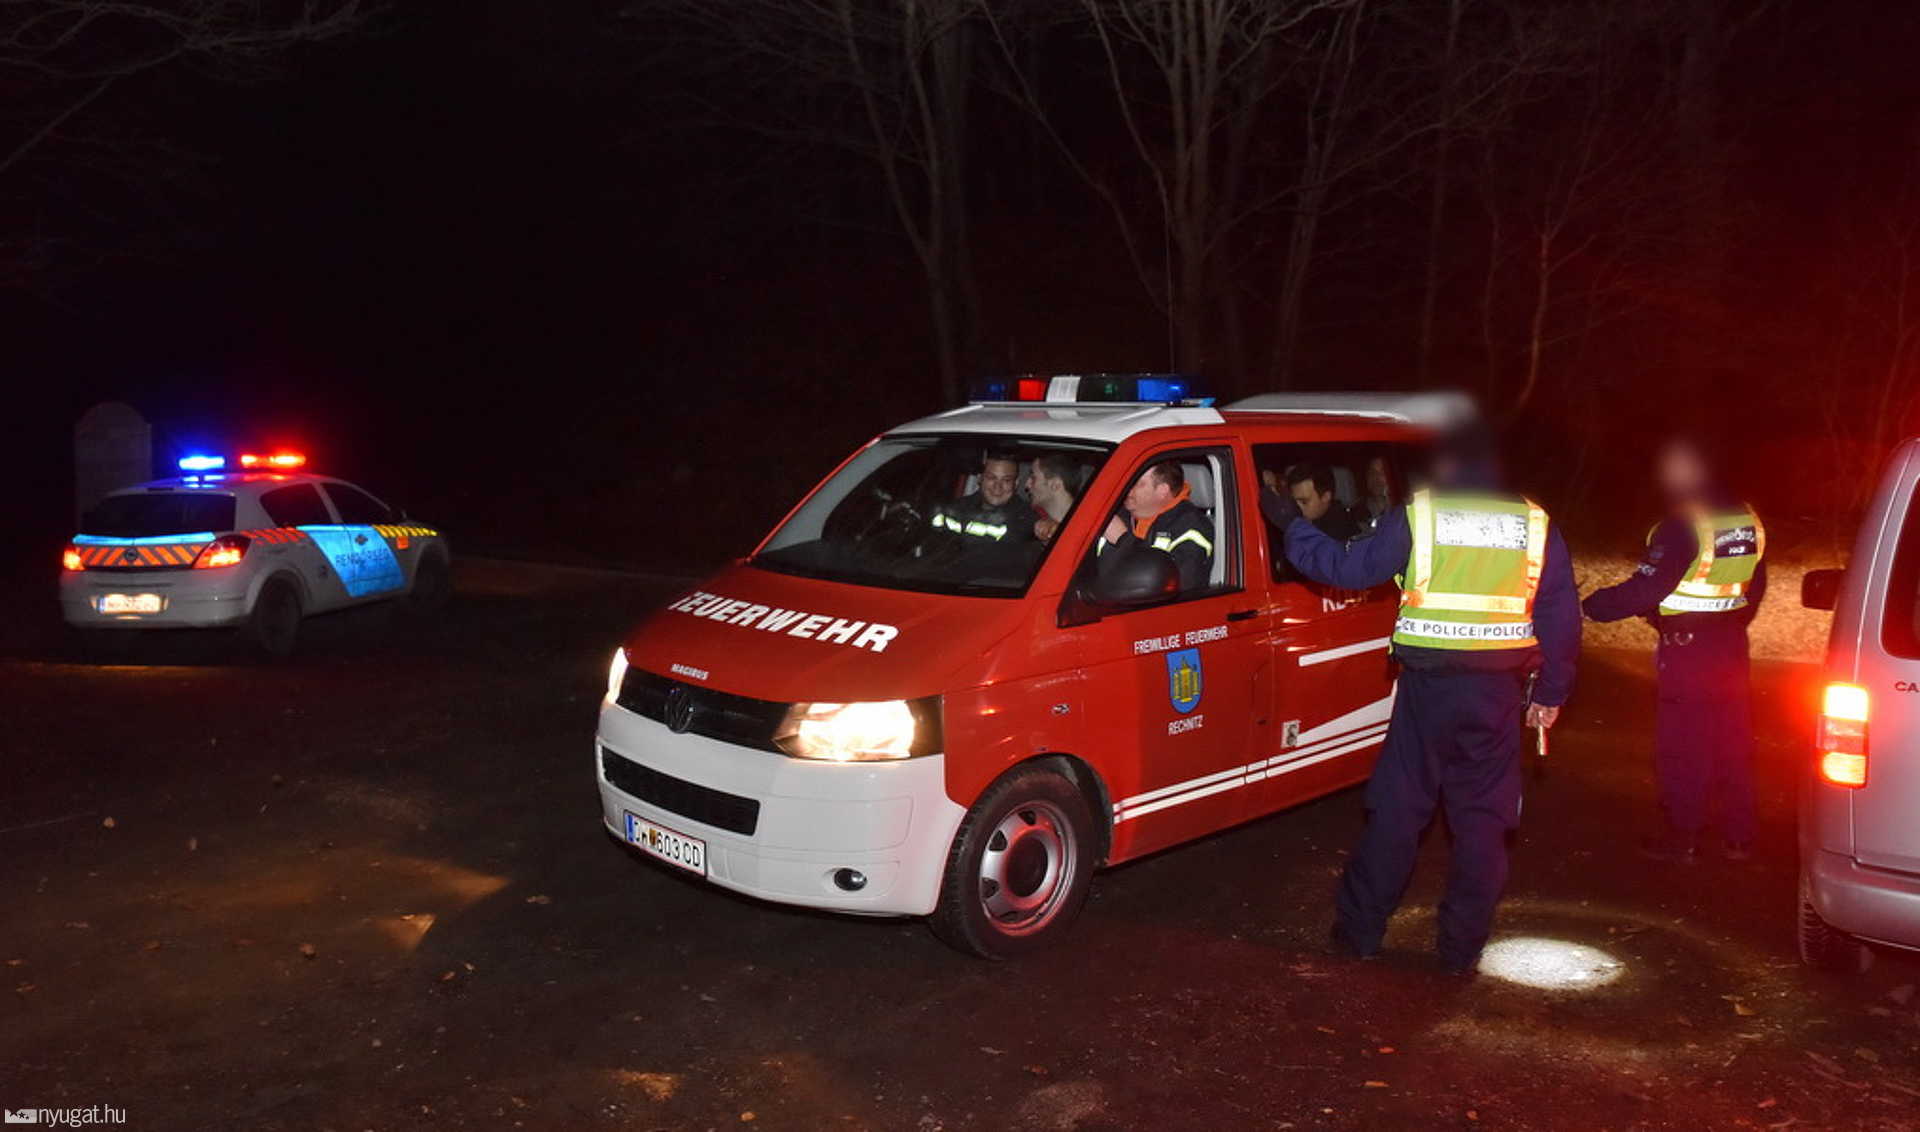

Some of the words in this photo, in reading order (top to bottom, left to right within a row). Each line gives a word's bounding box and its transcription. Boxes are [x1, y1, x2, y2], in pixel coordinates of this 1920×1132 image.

[667, 591, 899, 652] FEUERWEHR
[1423, 623, 1478, 637] POLICE
[1134, 634, 1180, 655] FREIWILLIGE
[1185, 625, 1228, 645] FEUERWEHR
[671, 663, 709, 681] MAGIRUS
[1168, 714, 1204, 736] RECHNITZ
